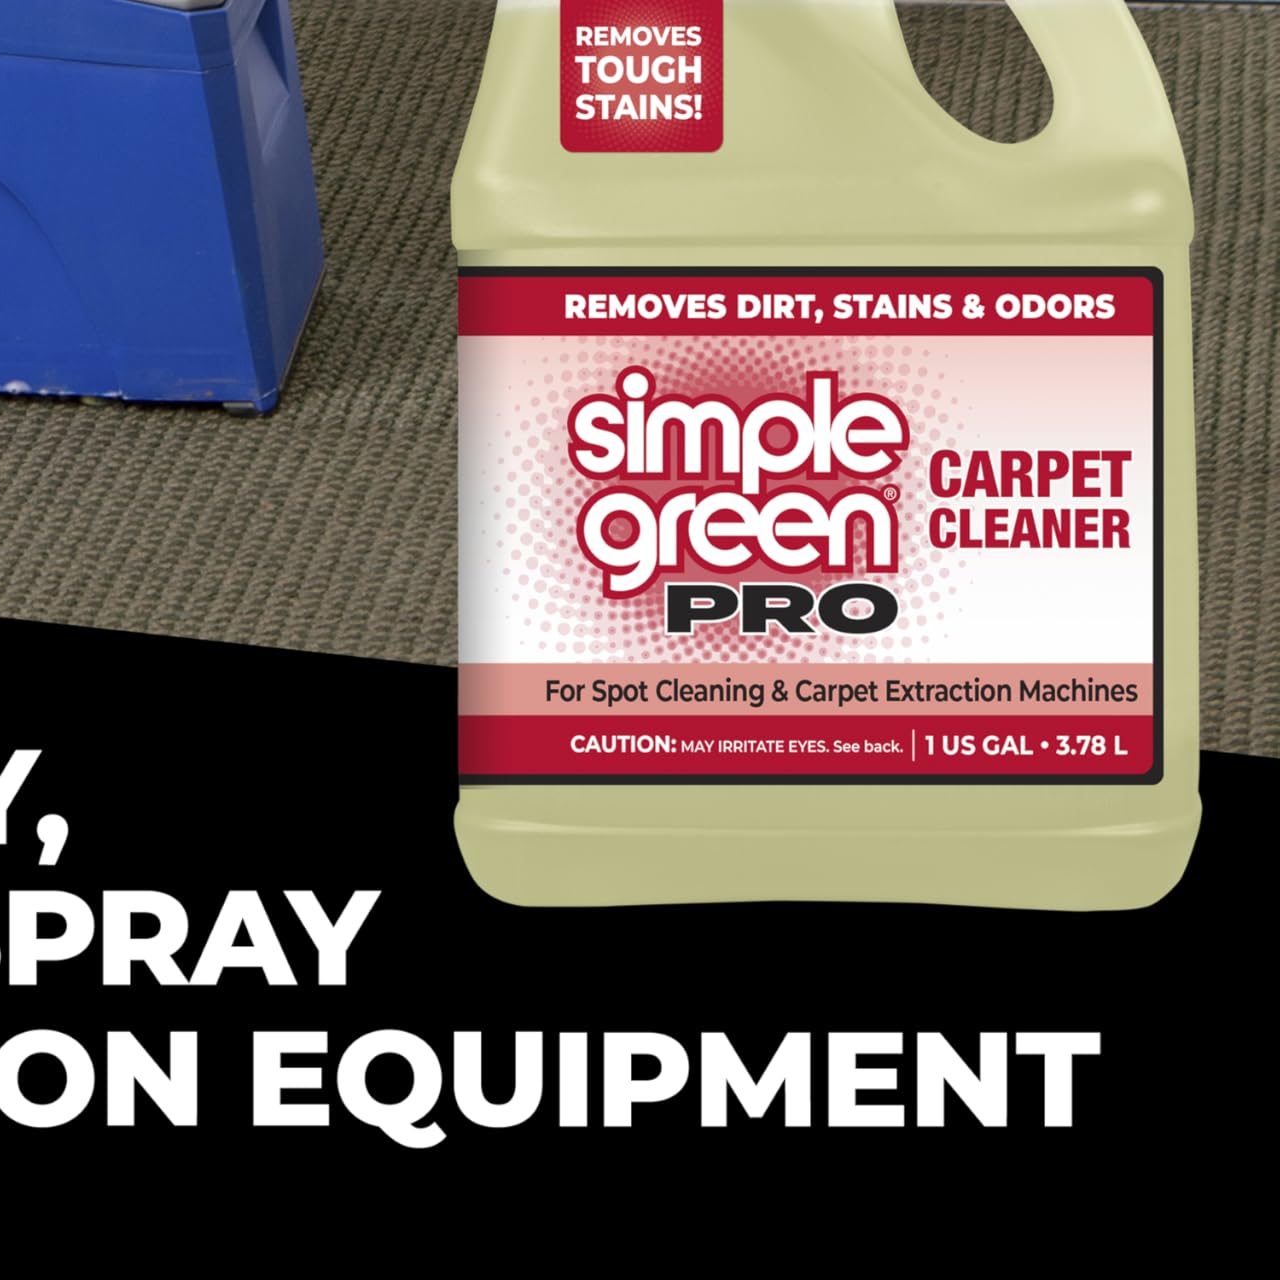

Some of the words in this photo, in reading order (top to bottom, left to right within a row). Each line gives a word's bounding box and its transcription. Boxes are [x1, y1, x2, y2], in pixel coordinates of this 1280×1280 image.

[574, 25, 702, 47] REMOVES
[574, 55, 702, 84] TOUGH
[574, 93, 703, 120] STAINS!
[564, 293, 727, 320] REMOVES
[737, 294, 824, 324] DIRT,
[833, 293, 953, 320] STAINS
[962, 293, 985, 320] &
[995, 293, 1116, 320] ODORS
[570, 367, 907, 496] simple
[928, 449, 1132, 498] CARPET
[928, 507, 1131, 549] CLEANER
[666, 583, 899, 634] PRO
[545, 679, 586, 703] For
[592, 679, 649, 708] Spot
[655, 677, 765, 708] Cleaning
[771, 679, 789, 703] &
[795, 679, 879, 708] Carpet
[886, 677, 1012, 703] Extraction
[1019, 677, 1138, 703] Machines
[570, 734, 677, 753] CAUTION:
[681, 740, 715, 753] MAY
[718, 740, 785, 753] IRRITATE
[788, 739, 830, 753] EYES.
[833, 739, 861, 753] See
[864, 739, 904, 753] back.
[925, 735, 934, 755] 1
[942, 735, 976, 756] US
[982, 735, 1034, 756] GAL
[1055, 735, 1106, 756] 3.78
[1114, 735, 1129, 756] L
